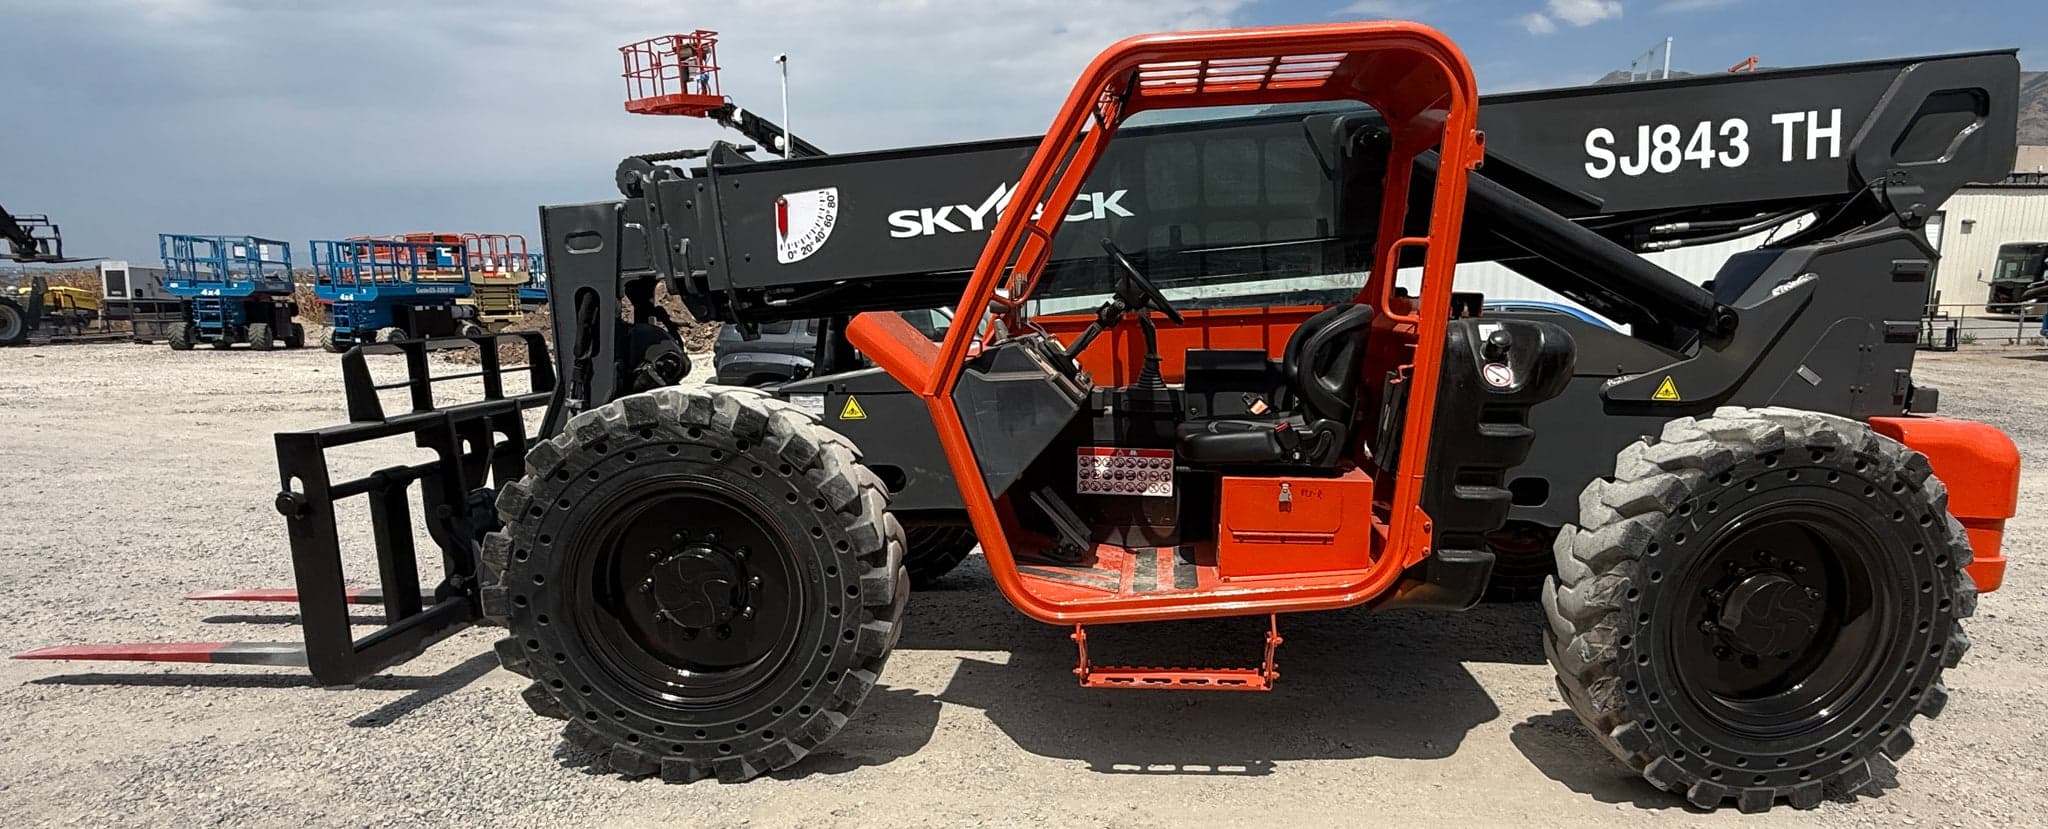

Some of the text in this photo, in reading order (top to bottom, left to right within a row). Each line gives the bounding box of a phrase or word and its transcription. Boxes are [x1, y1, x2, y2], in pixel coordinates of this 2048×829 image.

[1584, 108, 1842, 179] SJ843 TH
[788, 191, 836, 260] 0° 20° 40° 60° 80°
[888, 181, 1136, 238] SKYCK
[200, 288, 221, 296] 4x4
